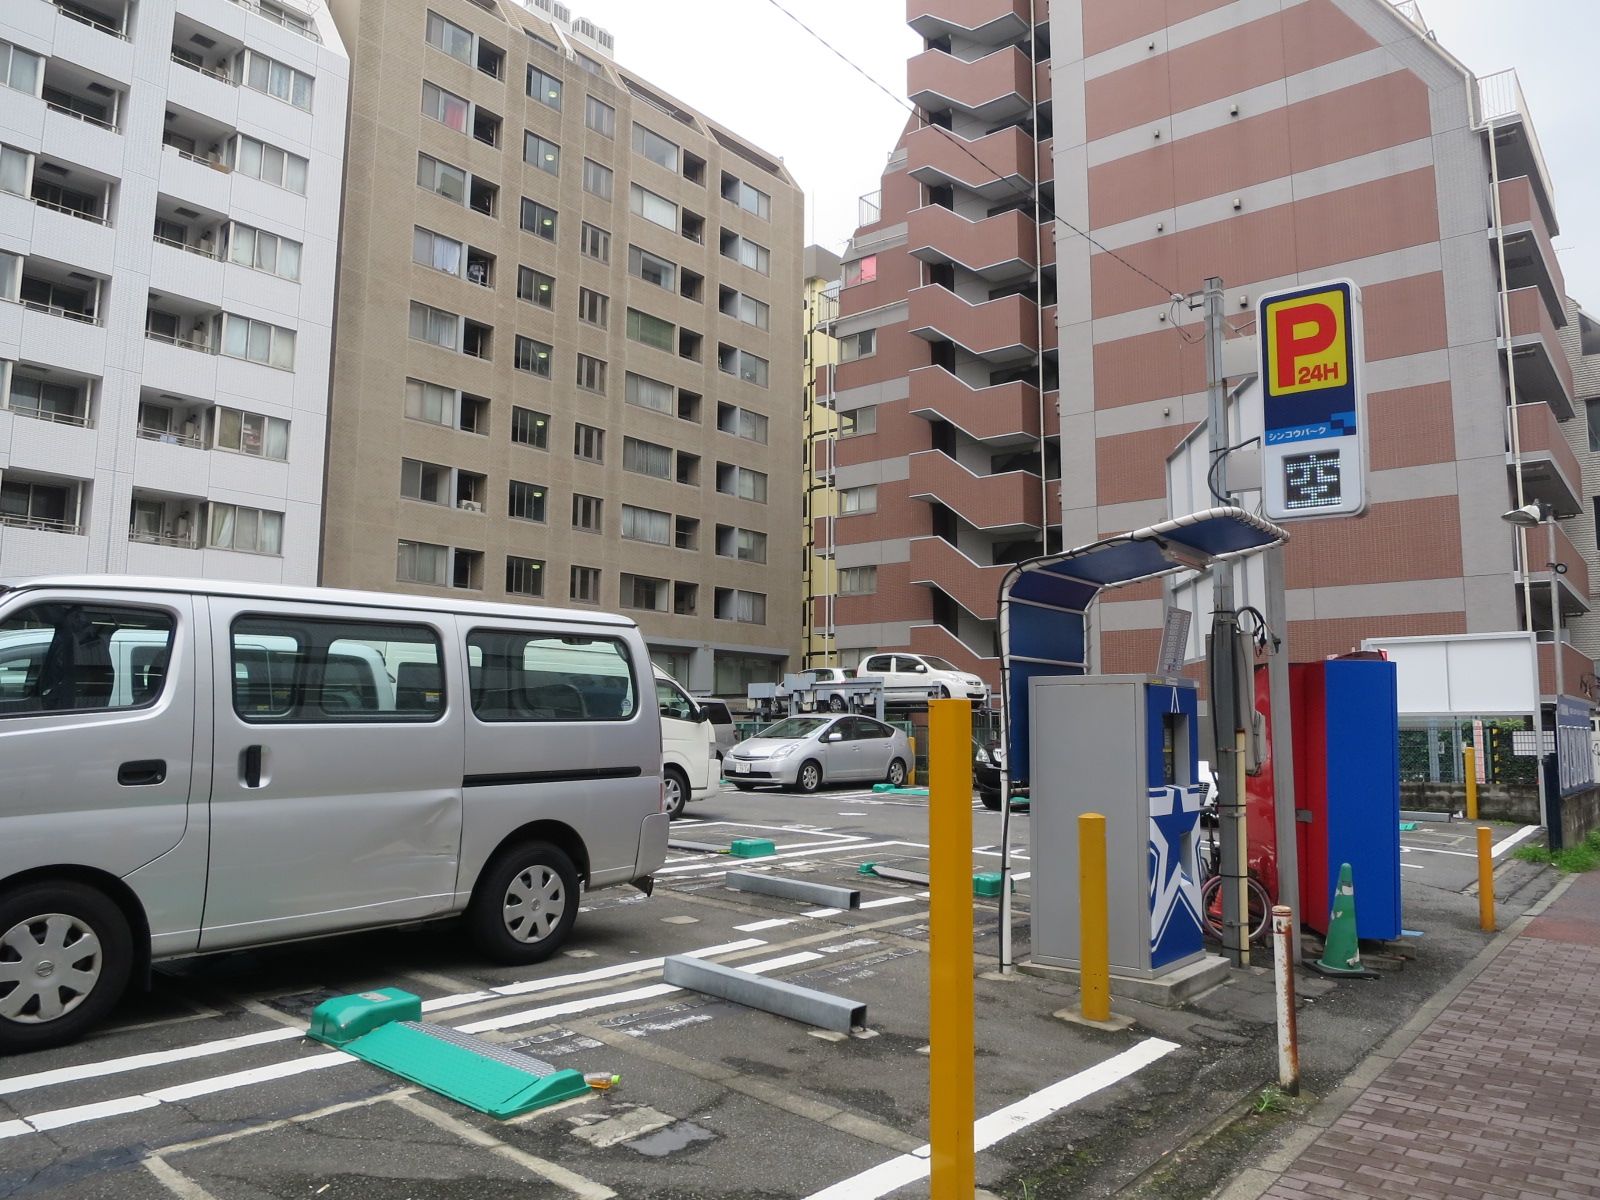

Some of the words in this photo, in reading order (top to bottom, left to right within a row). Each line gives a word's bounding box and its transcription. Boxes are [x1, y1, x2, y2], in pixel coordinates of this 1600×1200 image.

[1276, 303, 1337, 388] P
[1298, 362, 1338, 384] 24H
[1286, 454, 1341, 508] 空
